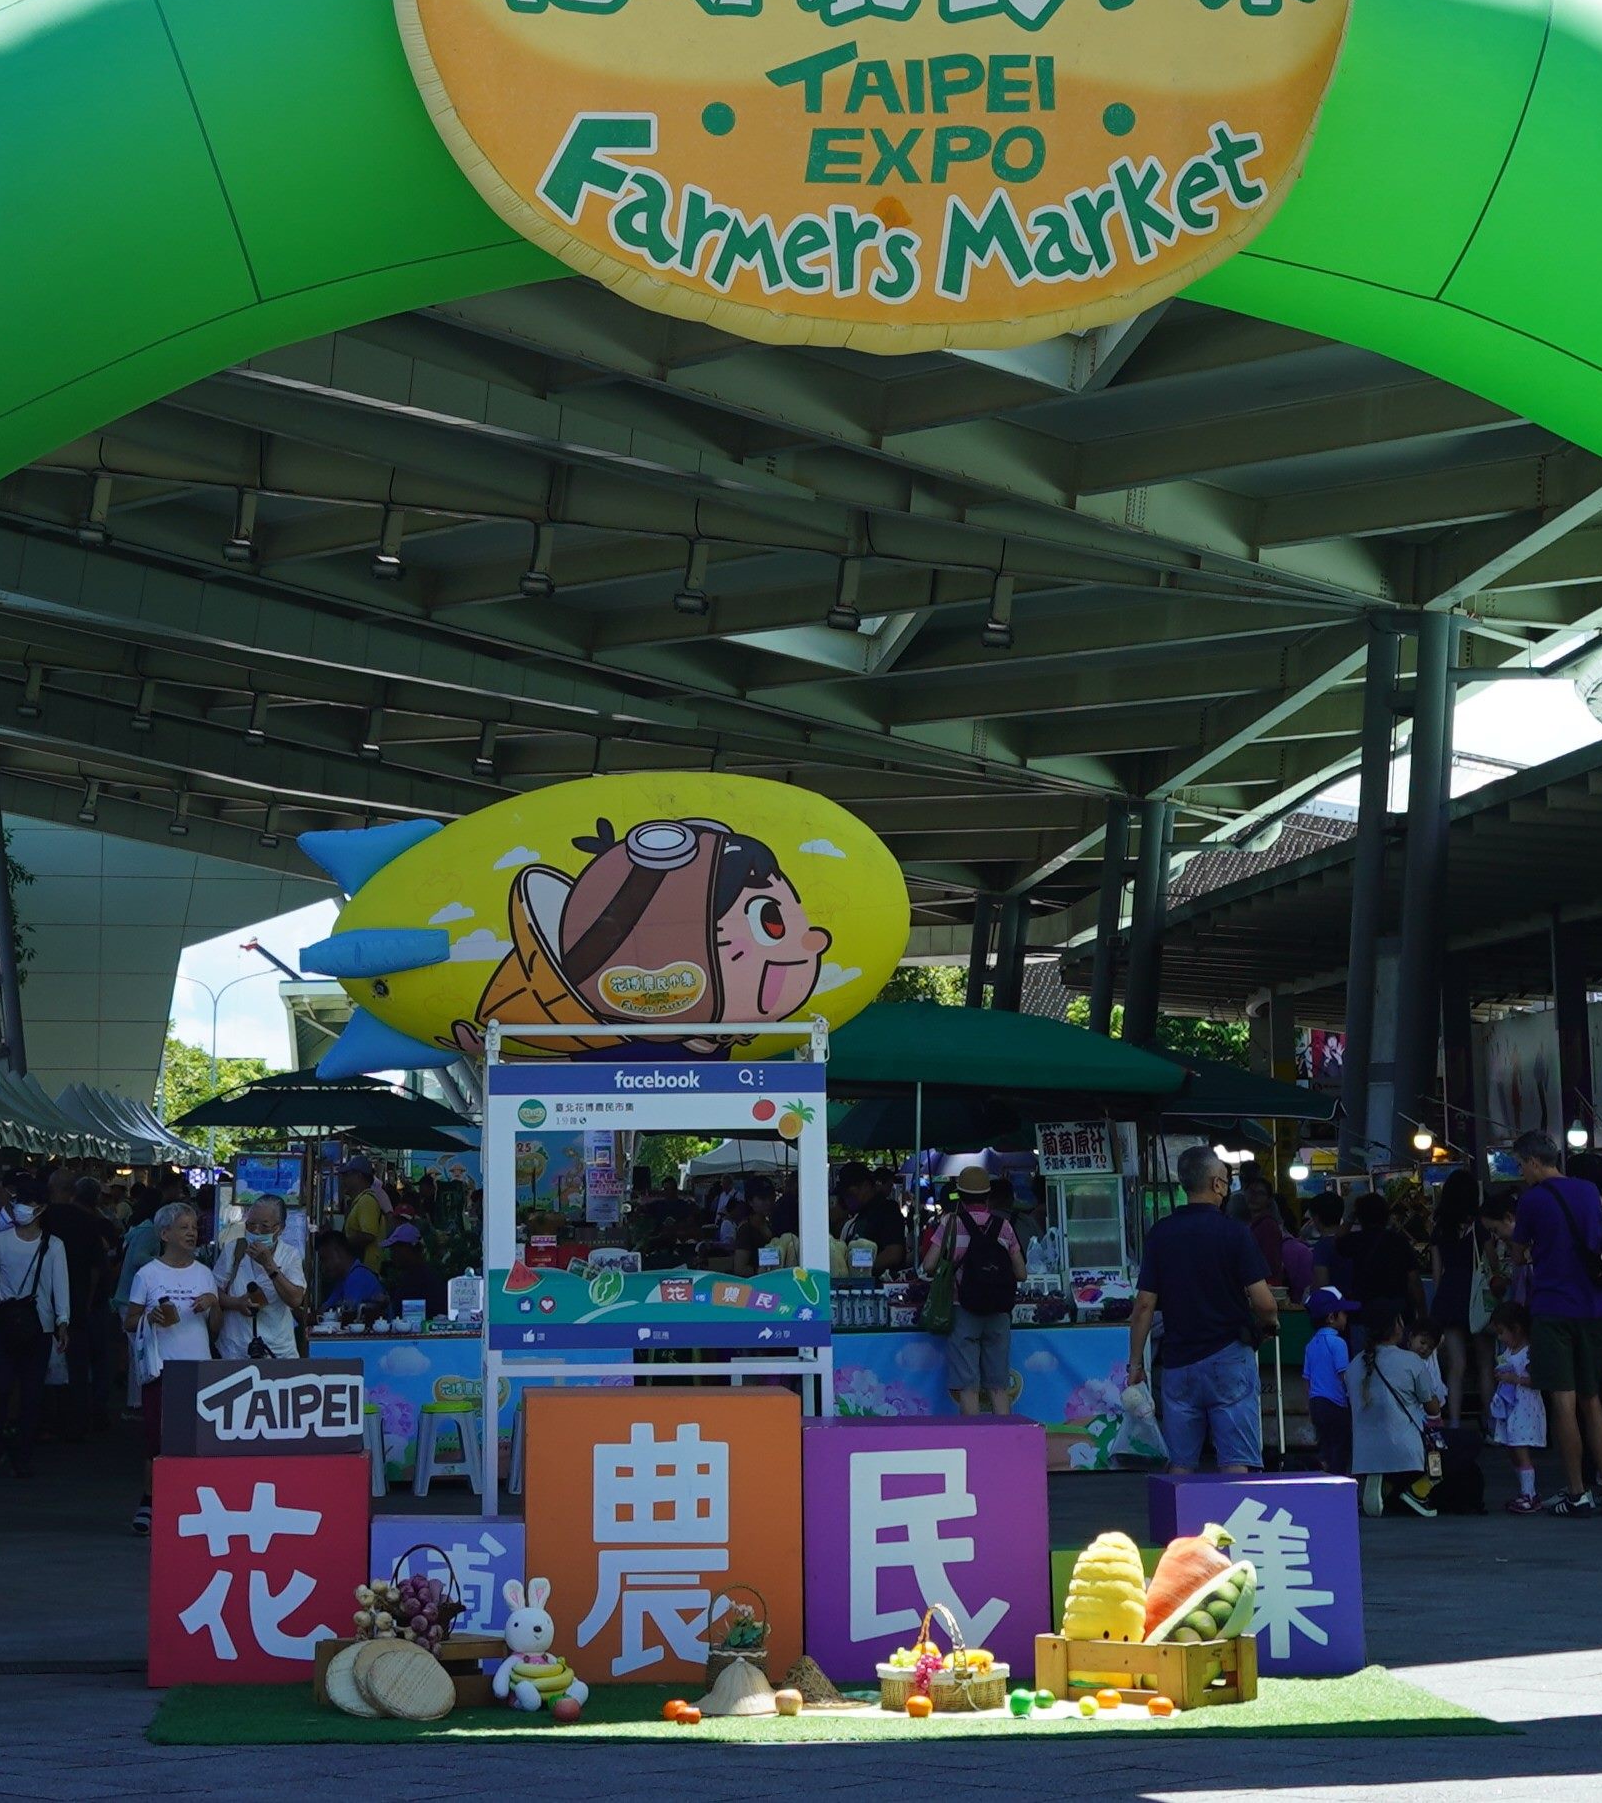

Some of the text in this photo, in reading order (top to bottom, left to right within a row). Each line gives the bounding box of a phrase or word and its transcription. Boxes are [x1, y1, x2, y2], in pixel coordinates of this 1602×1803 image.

[765, 41, 1055, 113] TAIPEI
[804, 126, 1046, 186] EXPO
[935, 122, 1265, 301] Market
[555, 1102, 634, 1114] 臺北花博農民市集
[614, 1070, 700, 1089] facebook
[1042, 1128, 1105, 1156] 葡萄原汁
[198, 1367, 363, 1439] TAIPEI
[178, 1482, 338, 1660] 花
[576, 1422, 731, 1677] 農
[849, 1447, 1010, 1649] 民
[1223, 1496, 1335, 1659] 集
